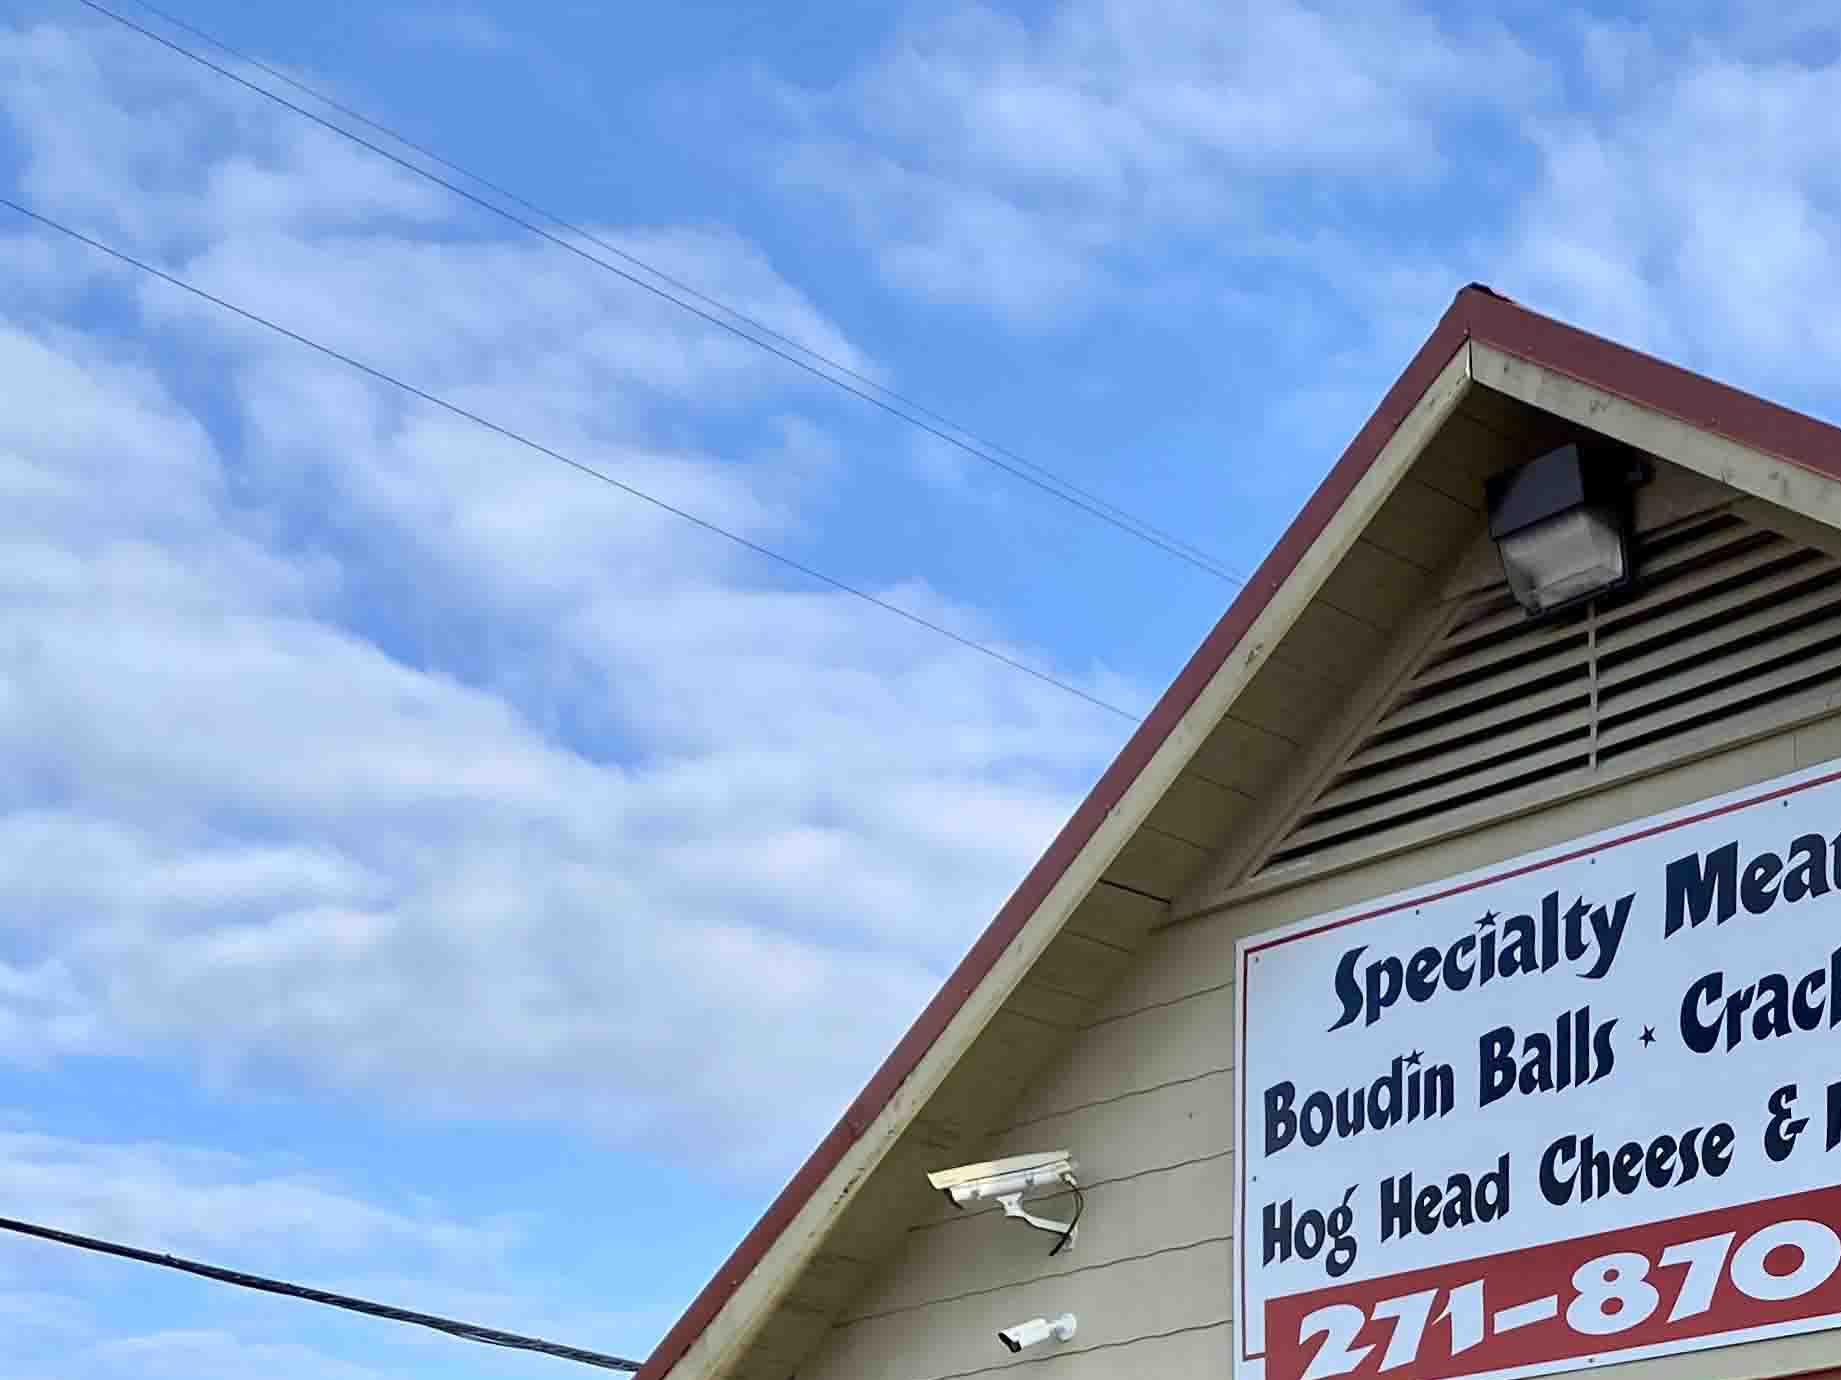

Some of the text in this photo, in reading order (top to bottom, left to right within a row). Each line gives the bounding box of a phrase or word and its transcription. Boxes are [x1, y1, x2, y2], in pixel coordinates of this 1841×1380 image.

[1328, 890, 1636, 1032] Specialty
[1264, 1050, 1454, 1157] Boudin
[1480, 1006, 1618, 1108] Balls
[1262, 1183, 1359, 1277] Hog
[1381, 1152, 1509, 1243] Head
[1539, 1132, 1734, 1207] Cheese
[1764, 1084, 1809, 1161] &
